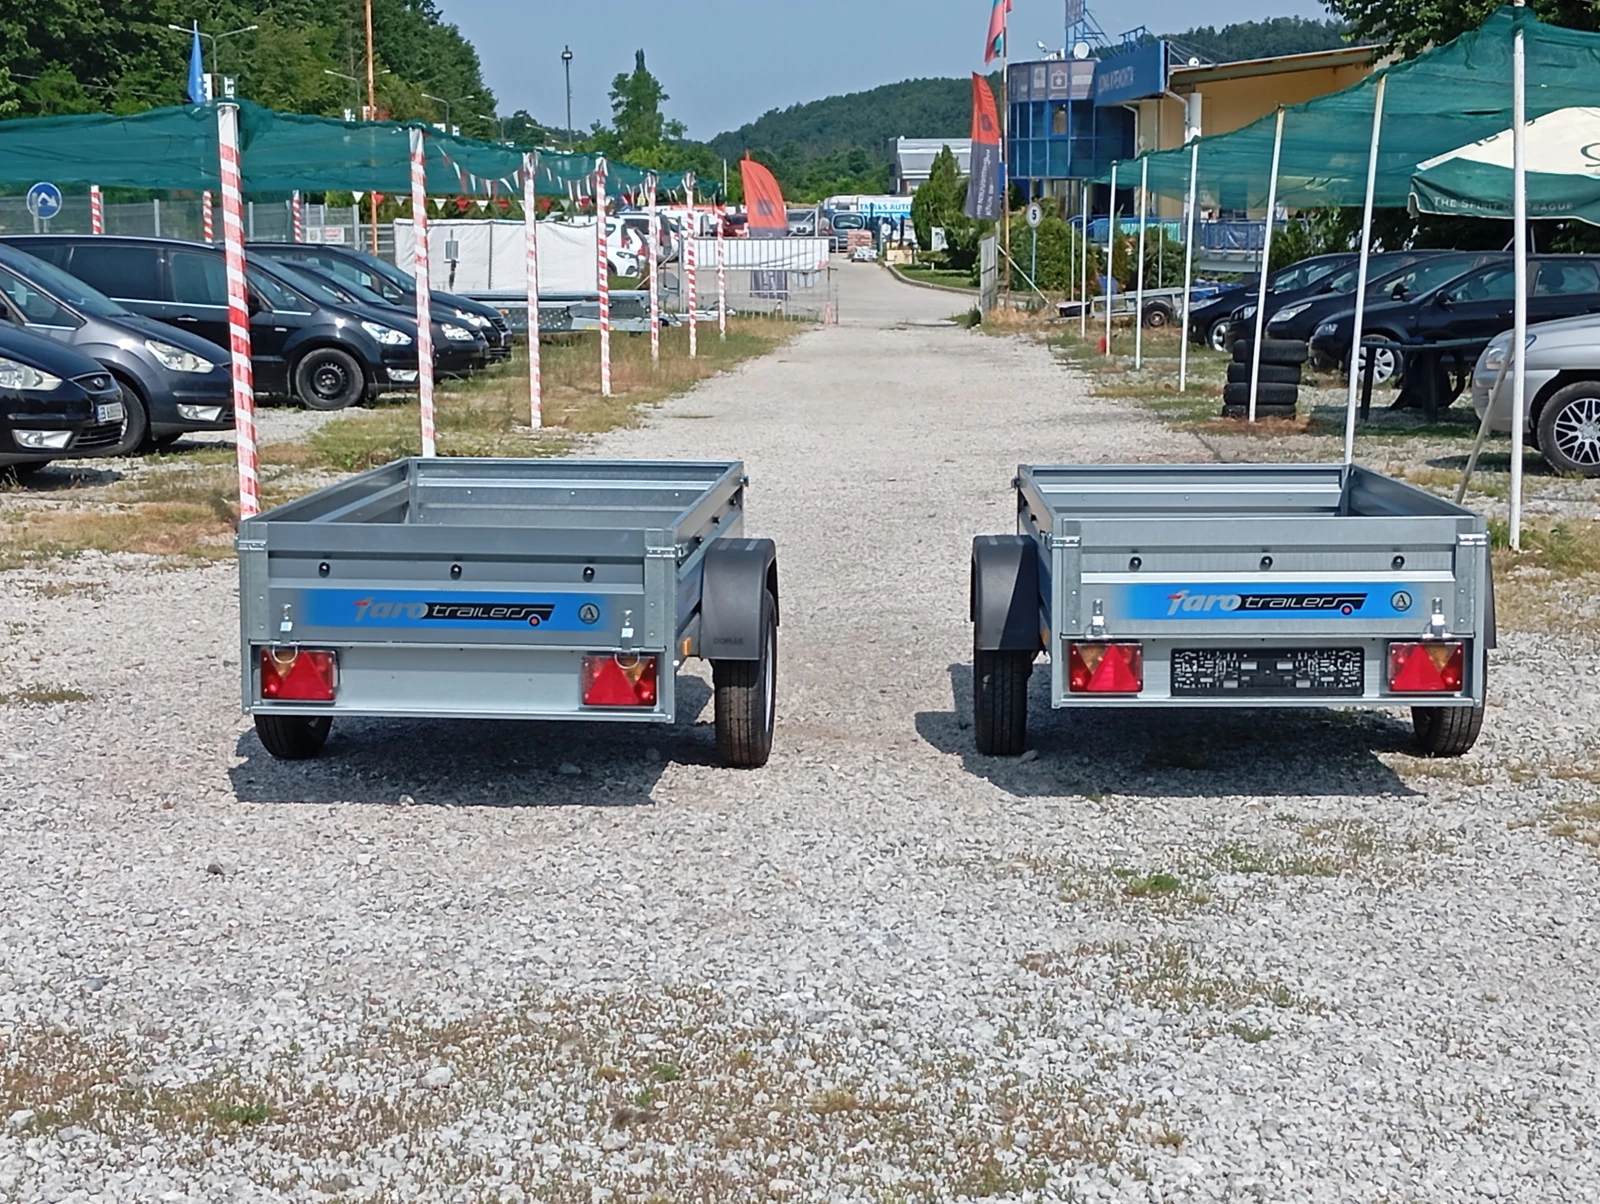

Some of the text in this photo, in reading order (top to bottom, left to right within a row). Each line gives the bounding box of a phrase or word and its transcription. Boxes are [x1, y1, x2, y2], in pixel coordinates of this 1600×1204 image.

[1433, 197, 1457, 207] THE
[1460, 199, 1499, 211] SPIRIT
[1527, 202, 1574, 212] PRAGUE
[1032, 209, 1037, 221] 5
[354, 596, 428, 622] faro
[1166, 589, 1242, 616] faro
